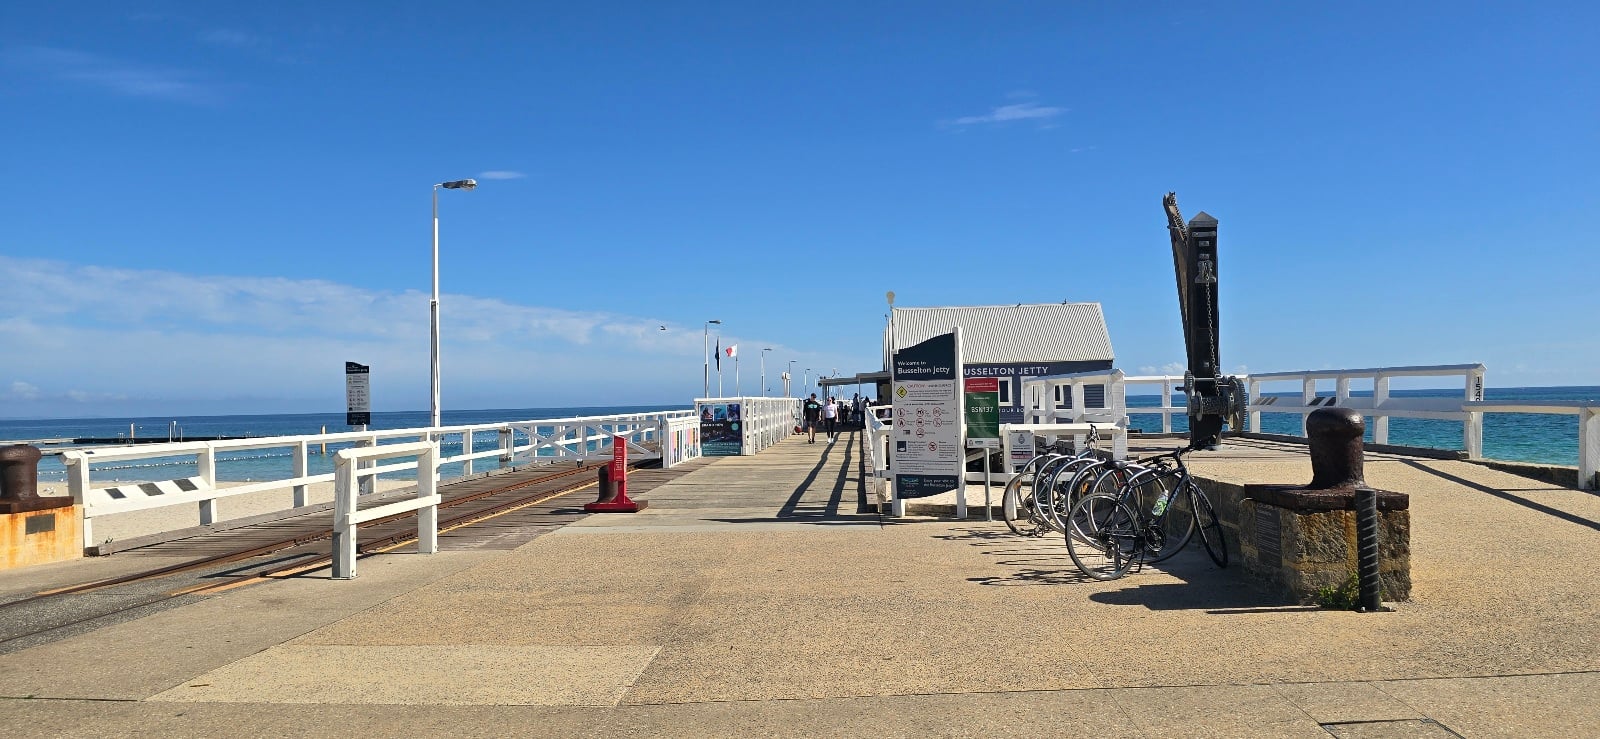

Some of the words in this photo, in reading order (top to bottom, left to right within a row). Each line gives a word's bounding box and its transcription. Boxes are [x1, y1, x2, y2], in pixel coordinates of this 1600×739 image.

[897, 367, 931, 375] Busselton
[932, 365, 950, 375] Jetty
[963, 367, 1015, 376] USSELTON
[1018, 366, 1049, 375] JETTY
